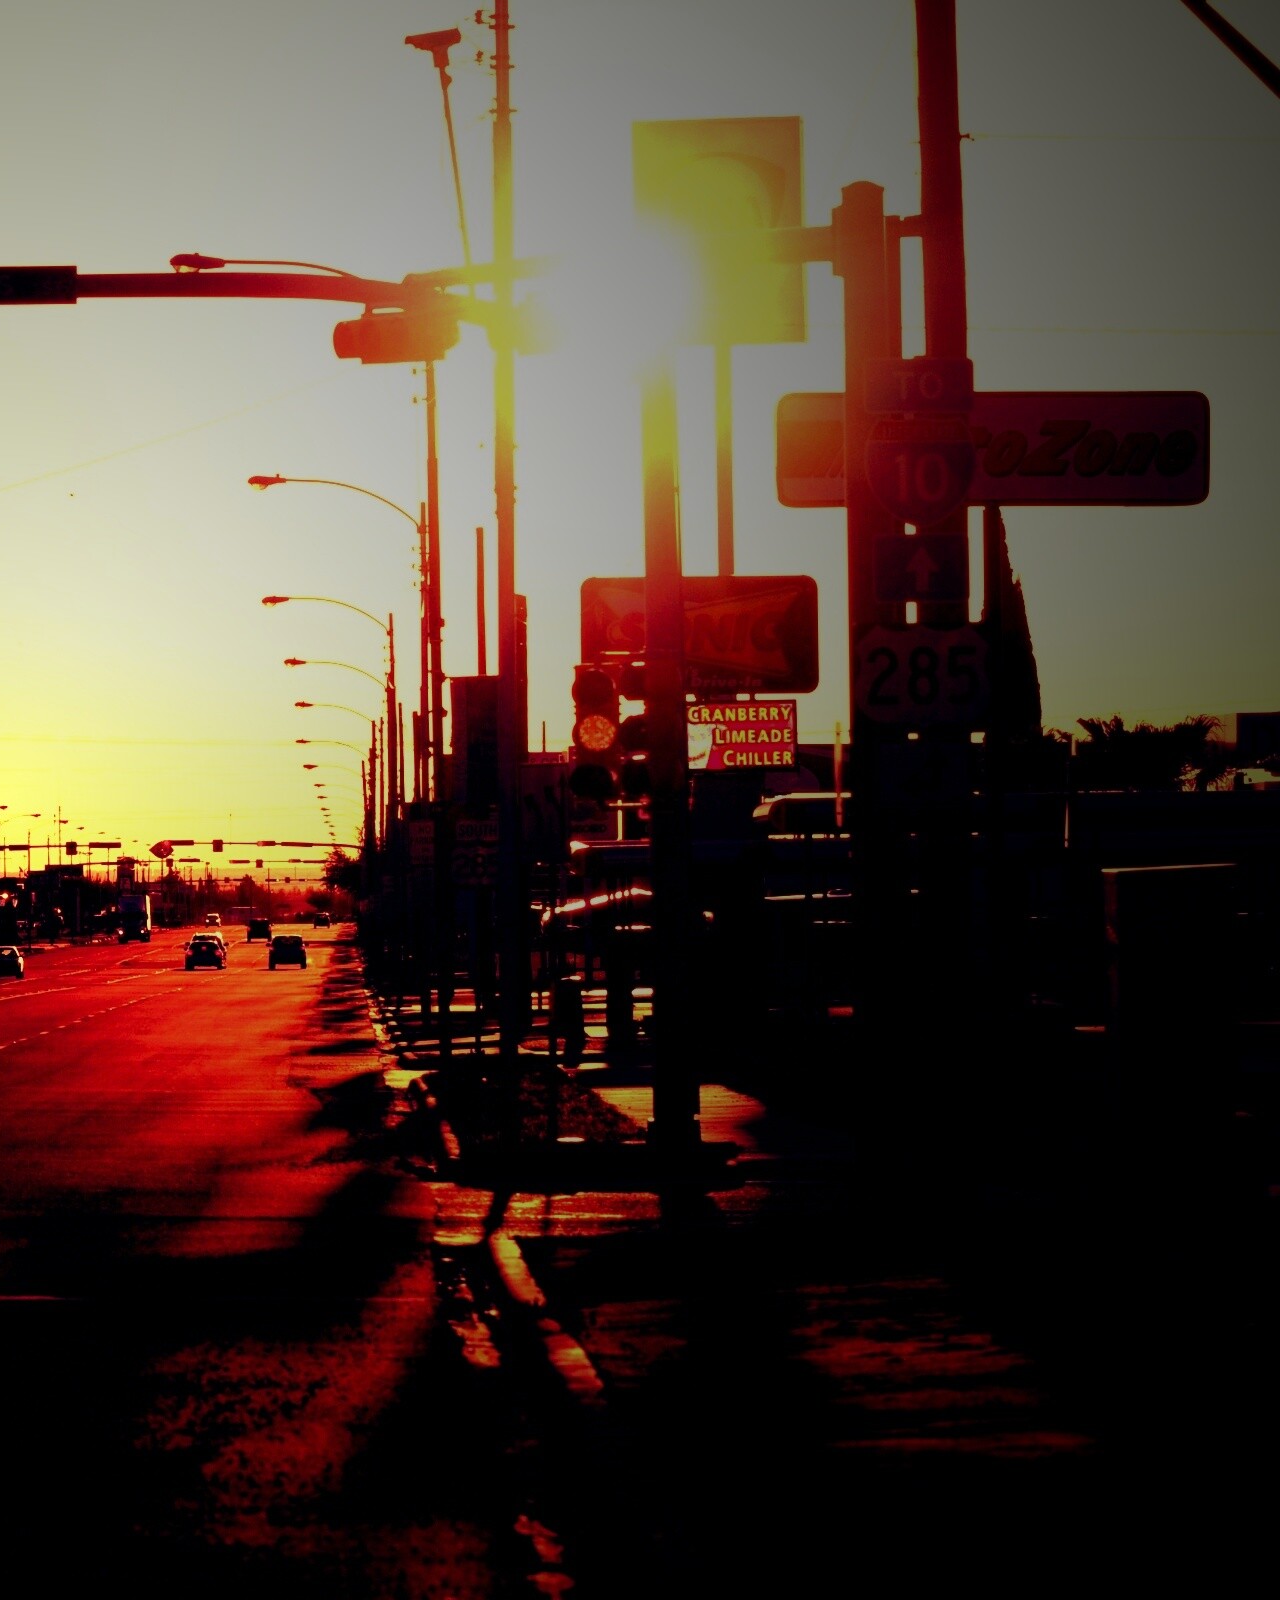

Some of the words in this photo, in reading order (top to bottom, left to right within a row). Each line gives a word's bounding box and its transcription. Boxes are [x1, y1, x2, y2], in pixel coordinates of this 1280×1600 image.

[893, 371, 942, 400] TO
[895, 453, 949, 501] 10
[606, 612, 784, 653] SNIC
[869, 647, 979, 704] 285
